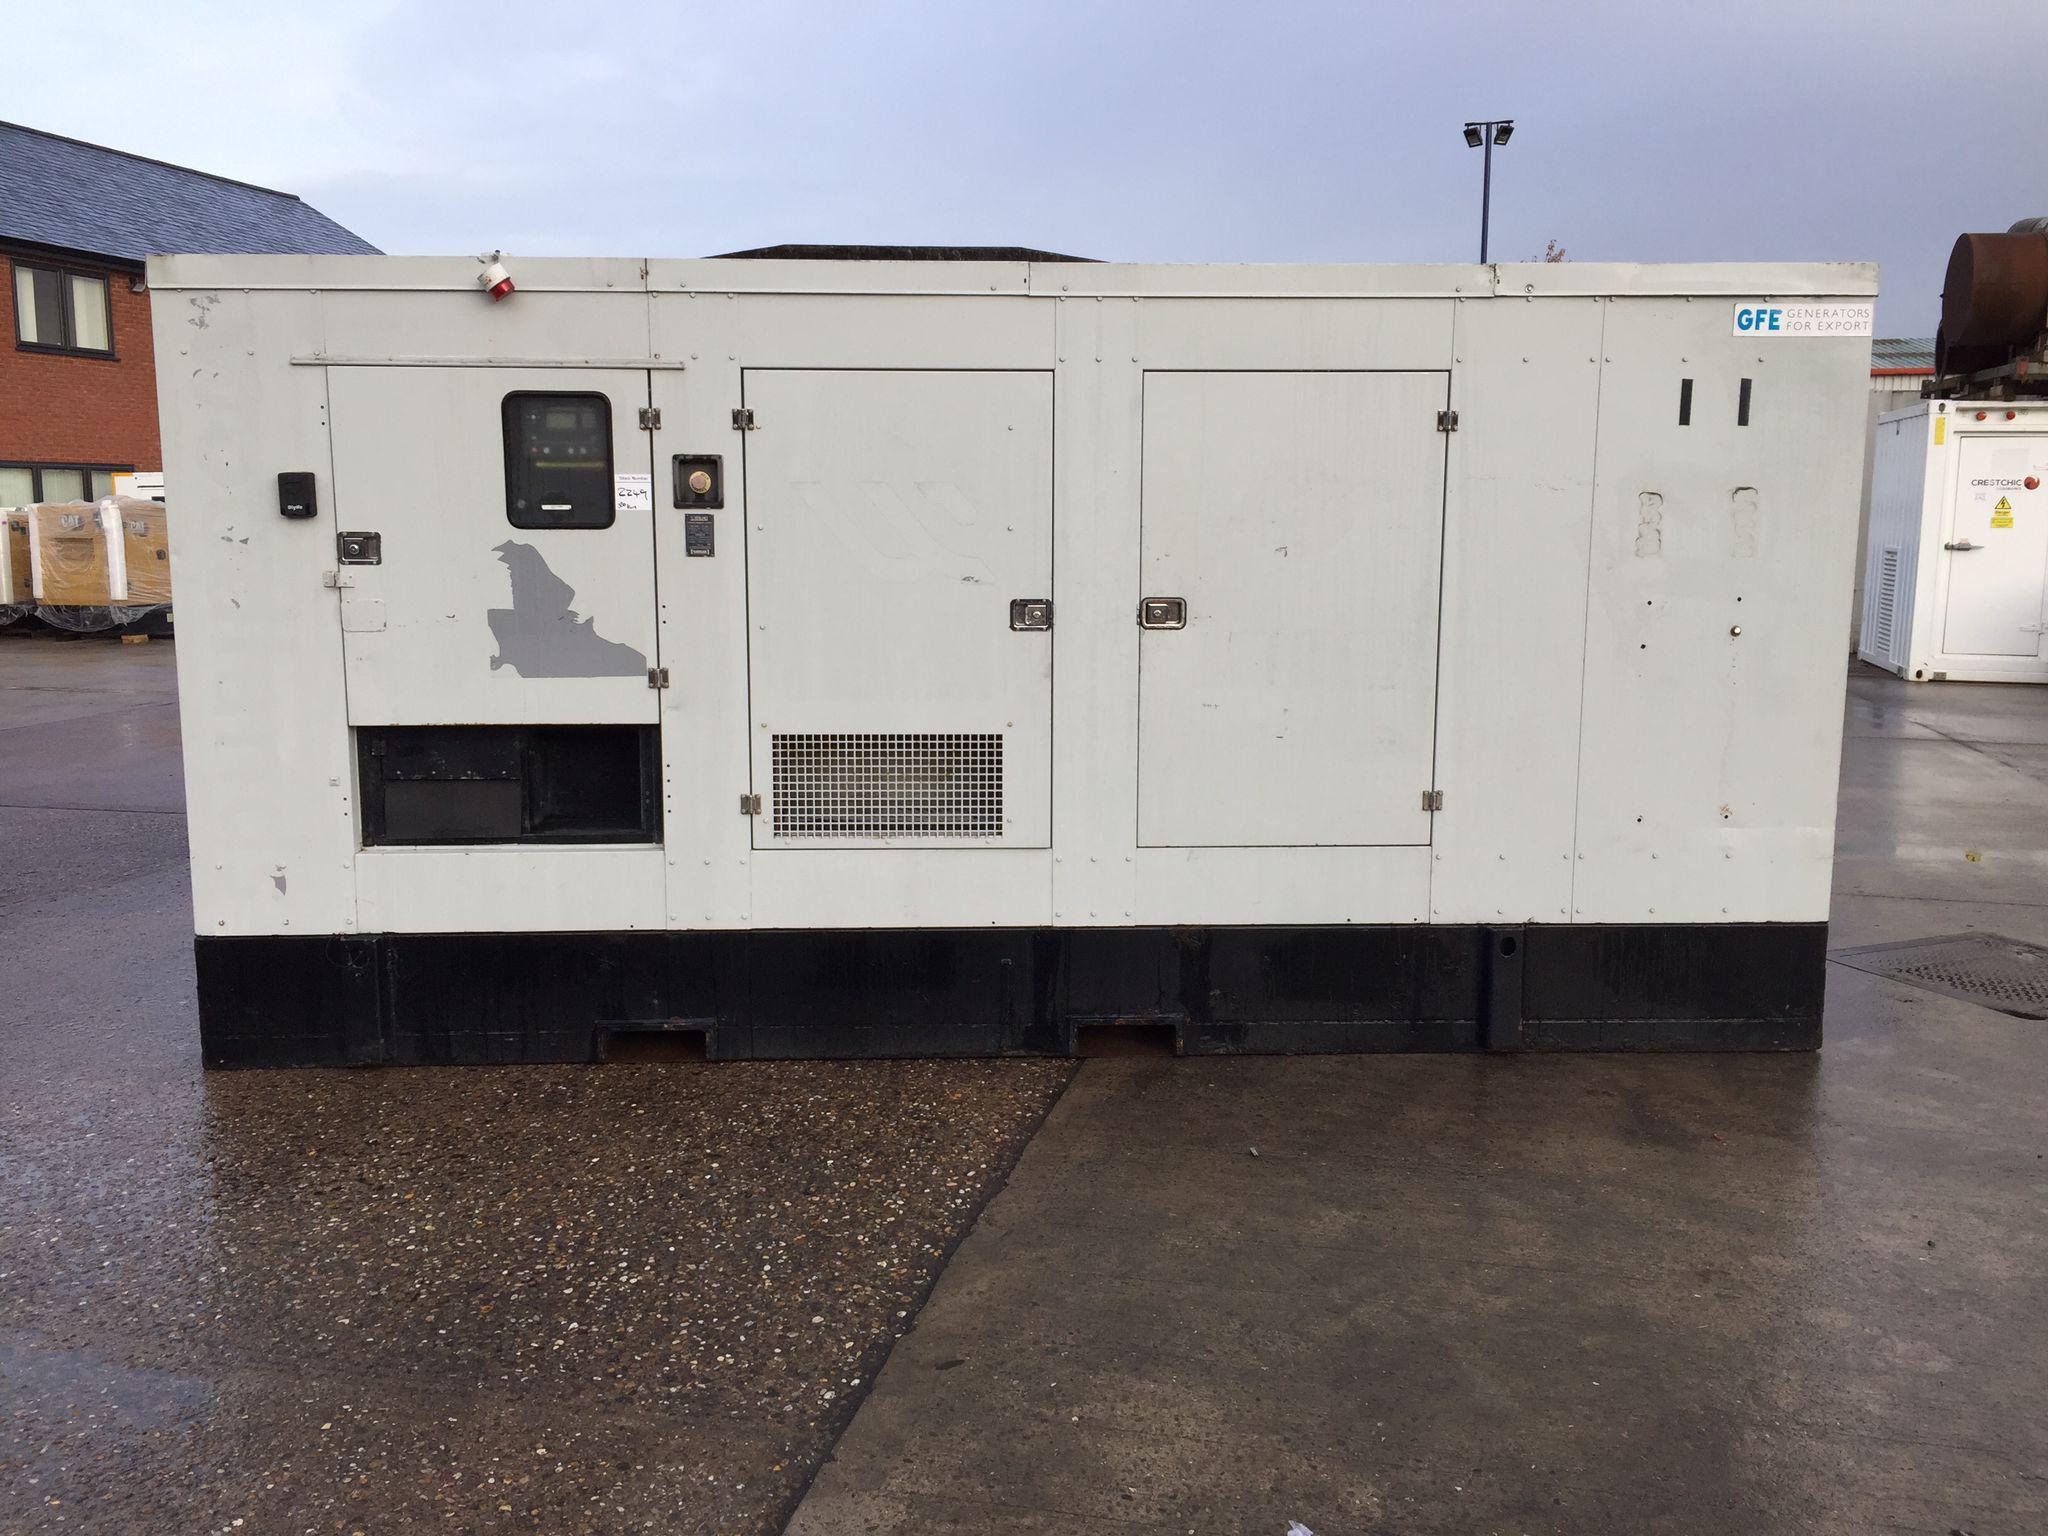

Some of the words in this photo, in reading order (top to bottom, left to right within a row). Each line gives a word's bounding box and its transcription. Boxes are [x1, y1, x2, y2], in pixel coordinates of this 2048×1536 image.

[1787, 308, 1870, 318] GENERATORS
[1737, 309, 1782, 331] GFE
[1786, 321, 1811, 331] FOR
[1818, 321, 1868, 331] EXPORT
[1971, 478, 2022, 487] CRESTCHIC
[60, 514, 80, 528] CAT
